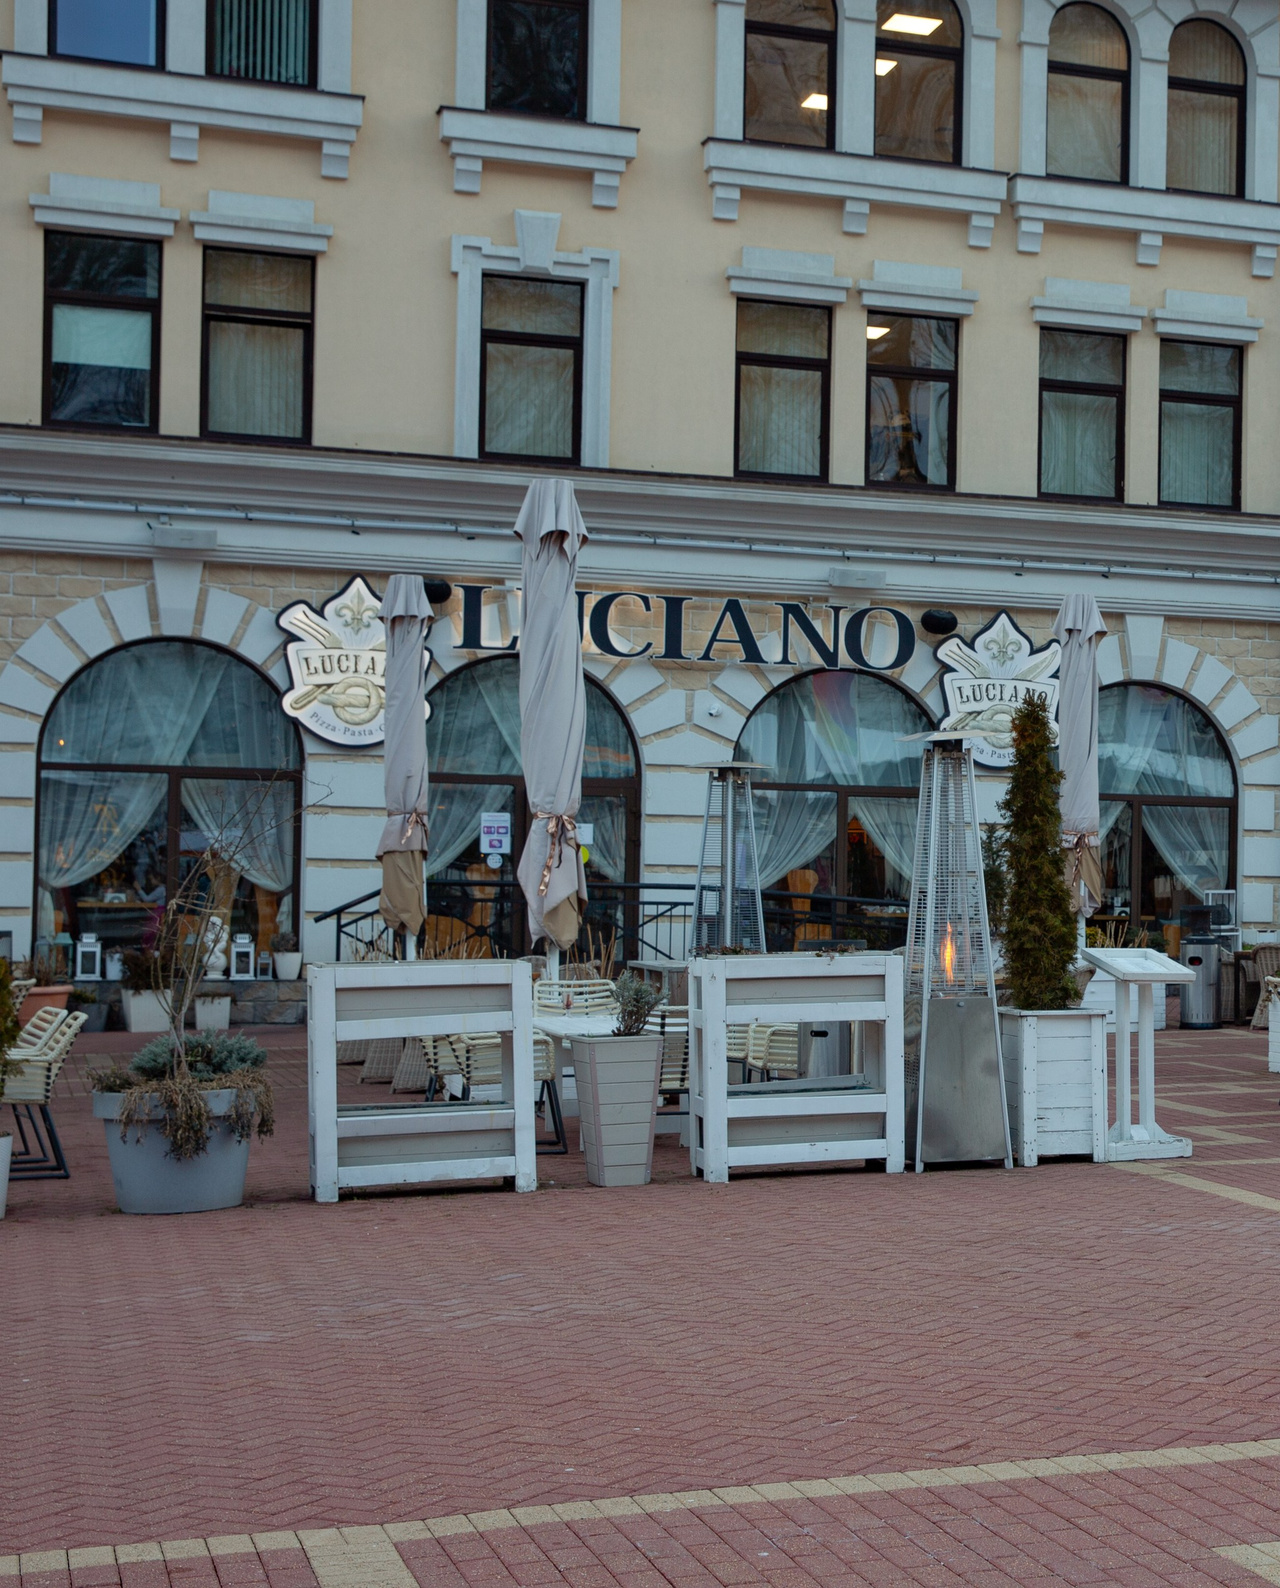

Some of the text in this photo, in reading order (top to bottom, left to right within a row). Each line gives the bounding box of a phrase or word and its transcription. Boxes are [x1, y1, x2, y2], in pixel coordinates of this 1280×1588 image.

[453, 584, 915, 669] LCIANO
[303, 654, 386, 677] LUCIA
[310, 711, 337, 732] Pizza
[343, 726, 374, 737] Pasta
